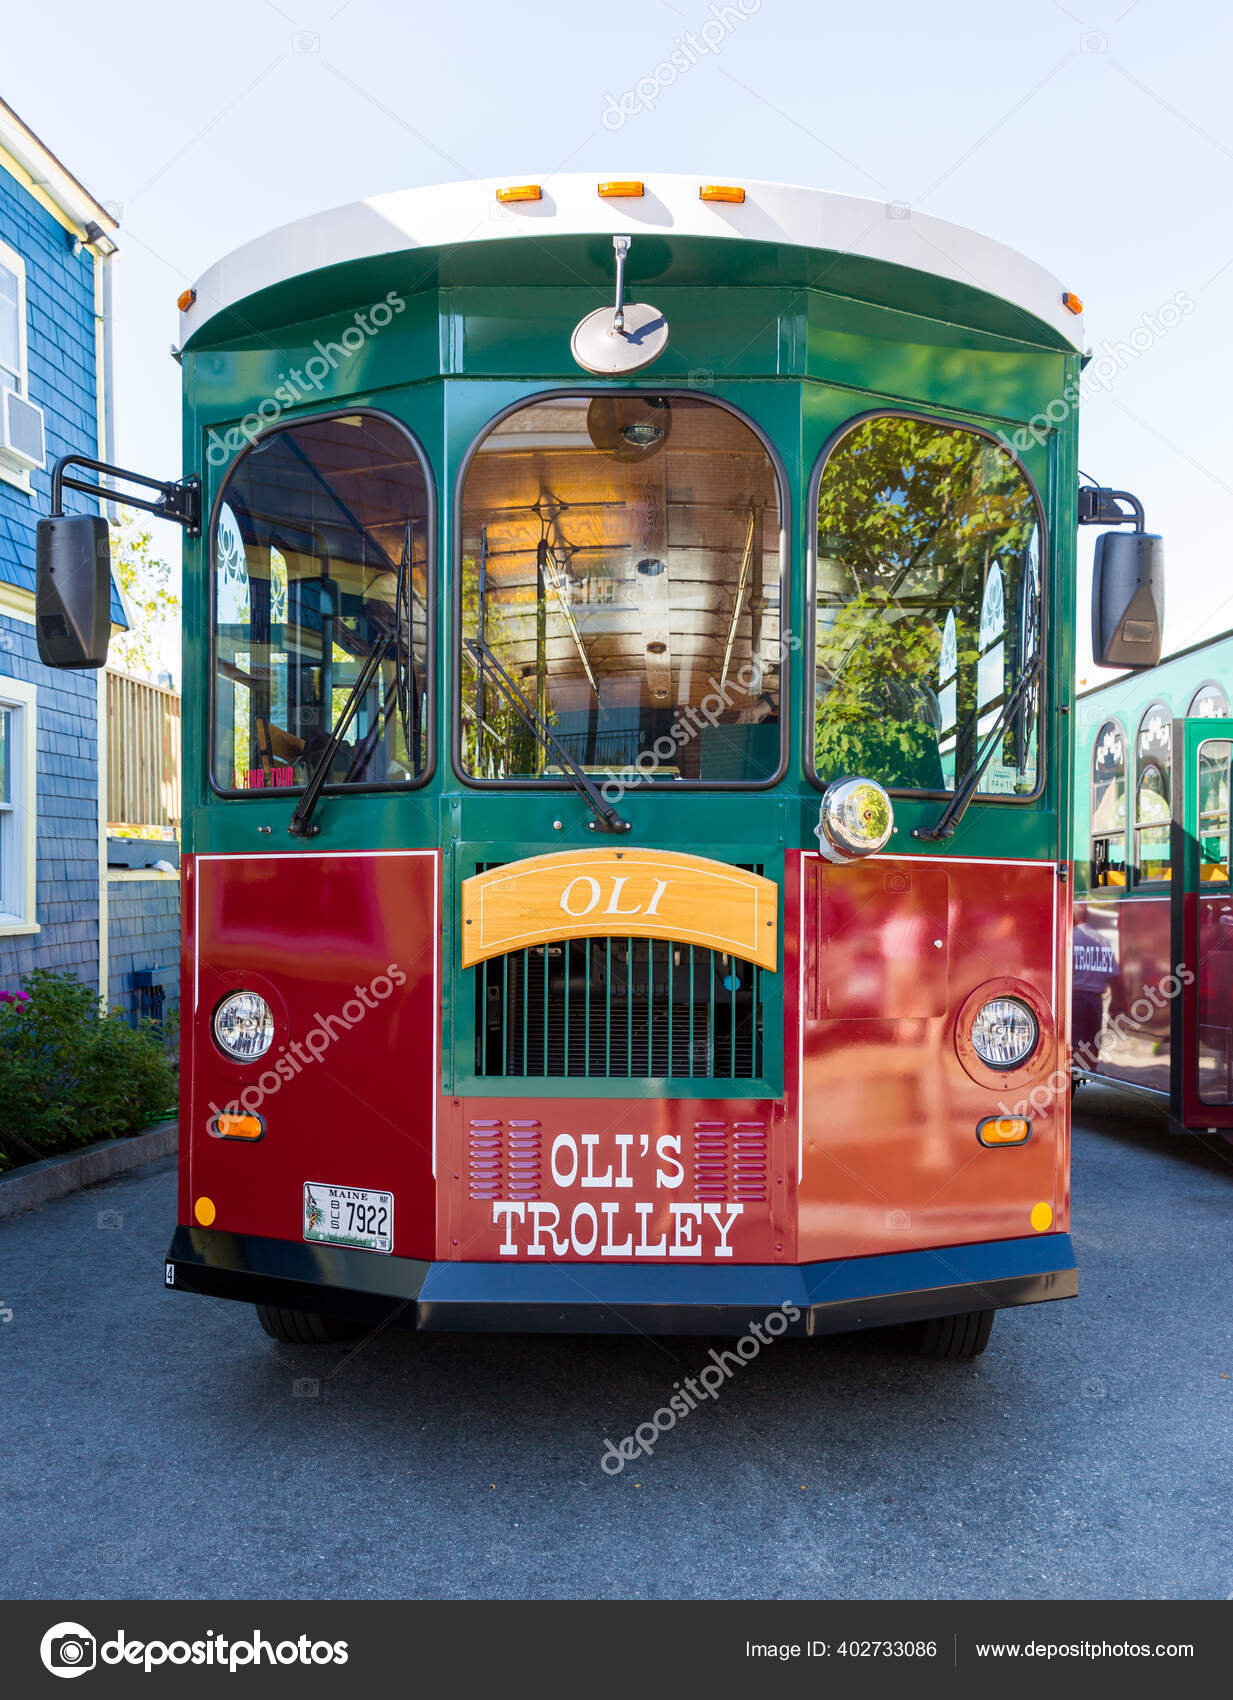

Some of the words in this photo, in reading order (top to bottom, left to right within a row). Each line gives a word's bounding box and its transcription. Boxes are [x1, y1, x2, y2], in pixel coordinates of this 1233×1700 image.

[243, 768, 265, 790] HOUR
[270, 766, 293, 788] TOUR
[560, 876, 674, 916] OLI
[1073, 945, 1113, 973] TROLLEY
[551, 1133, 685, 1189] OLI'S
[329, 1189, 368, 1201] MAINE
[330, 1199, 340, 1229] BUS
[346, 1202, 388, 1236] 7922
[492, 1201, 744, 1258] TROLLEY
[167, 1265, 173, 1283] 4
